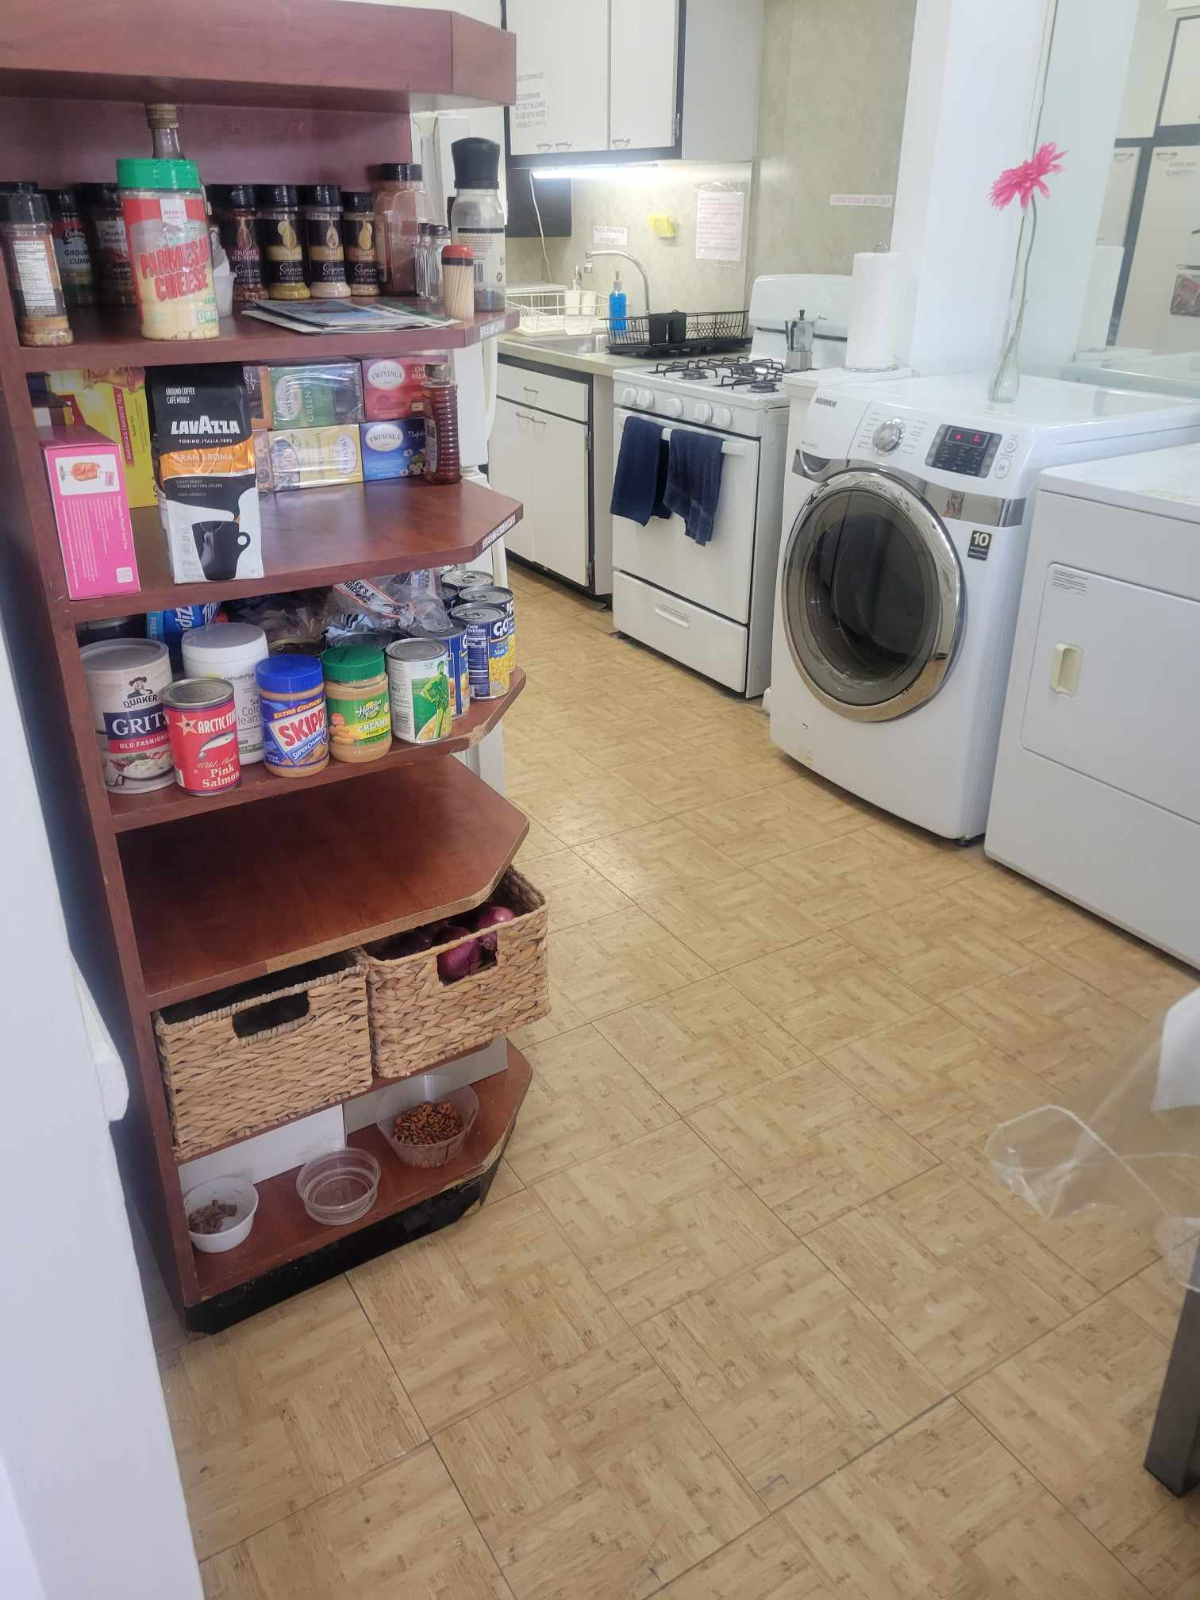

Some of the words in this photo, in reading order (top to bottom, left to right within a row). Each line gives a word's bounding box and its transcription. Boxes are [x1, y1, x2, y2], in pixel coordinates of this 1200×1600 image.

[155, 265, 209, 302] CHEESE
[371, 370, 403, 381] TWININGS
[165, 387, 182, 396] GROUND
[182, 387, 195, 396] COFFEE
[171, 415, 241, 435] LAVAZZA
[369, 432, 401, 444] TWININGS
[203, 453, 235, 461] AROMA
[973, 532, 990, 547] 10
[123, 694, 158, 708] QUAKER
[273, 708, 297, 719] EXTRA
[198, 716, 226, 734] ARCTIC
[210, 765, 235, 777] Pink
[202, 770, 240, 788] Salmon
